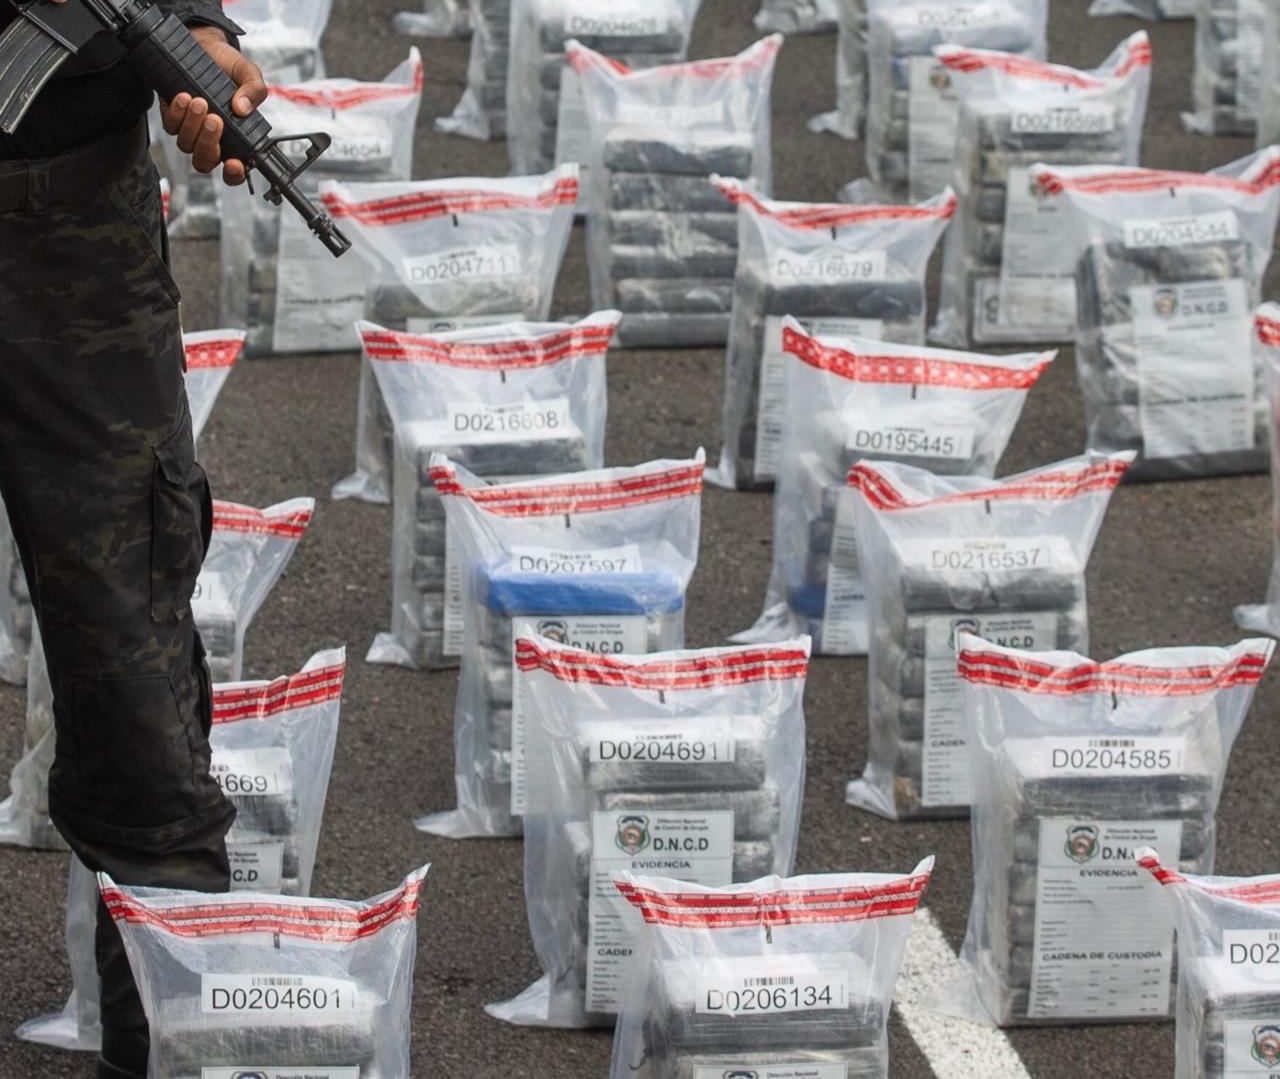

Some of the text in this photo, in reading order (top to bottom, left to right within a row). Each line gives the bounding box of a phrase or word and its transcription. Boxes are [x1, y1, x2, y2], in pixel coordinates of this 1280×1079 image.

[855, 430, 955, 454] D0195445
[520, 556, 627, 573] D0207597
[931, 548, 1040, 570] D0216537
[599, 740, 719, 762] D0204691
[1052, 748, 1172, 770] D0204585
[653, 837, 709, 852] D.N.C.D
[632, 861, 691, 870] EVIDENCIA
[1079, 869, 1139, 877] EVIDENCIA
[1042, 951, 1163, 961] CADENA DE CUSTODIA
[211, 988, 342, 1011] D0204601
[706, 984, 833, 1010] D0206134
[793, 1070, 819, 1078] Nacional
